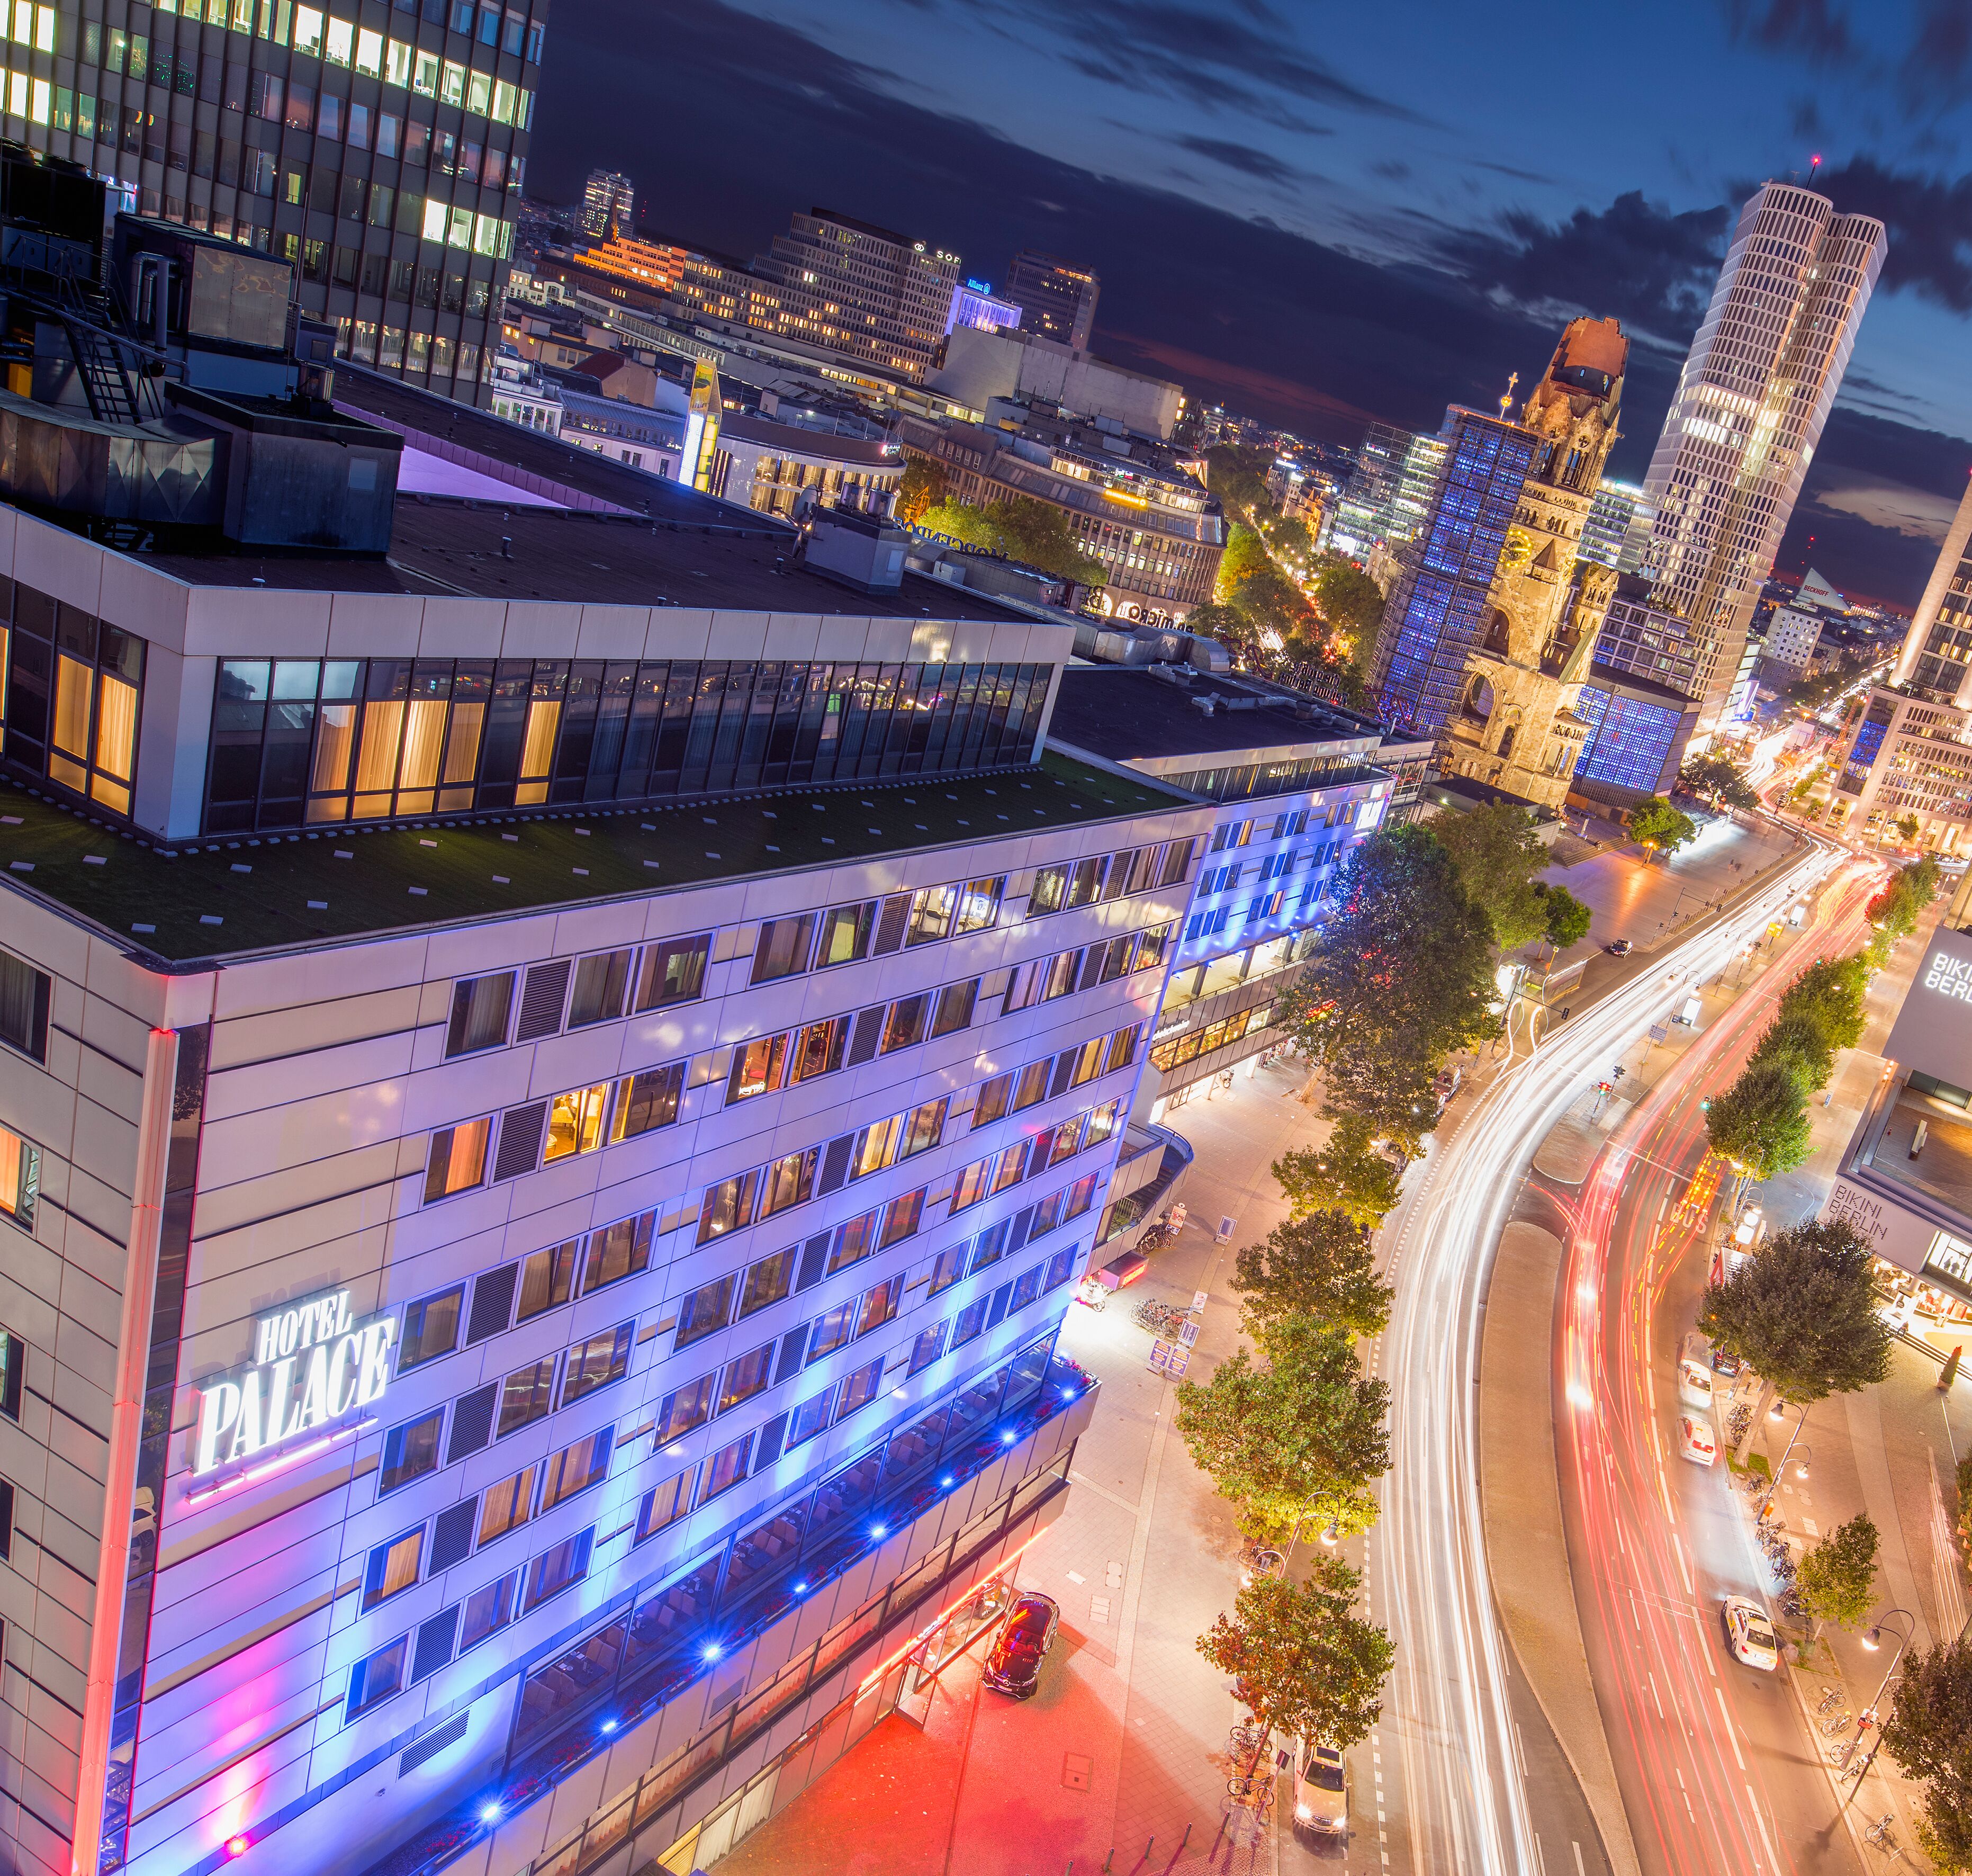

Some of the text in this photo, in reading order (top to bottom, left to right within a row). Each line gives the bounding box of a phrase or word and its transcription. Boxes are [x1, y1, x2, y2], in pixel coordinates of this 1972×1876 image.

[968, 279, 984, 291] Allianz
[1804, 585, 1829, 597] BECKHOFF
[1932, 953, 1972, 983] BIKI
[1669, 1202, 1709, 1234] BUS
[1835, 1184, 1882, 1219] BIKINI
[1829, 1199, 1888, 1240] BERLIN
[256, 1288, 352, 1366] HOTEL
[188, 1314, 395, 1477] PALACE
